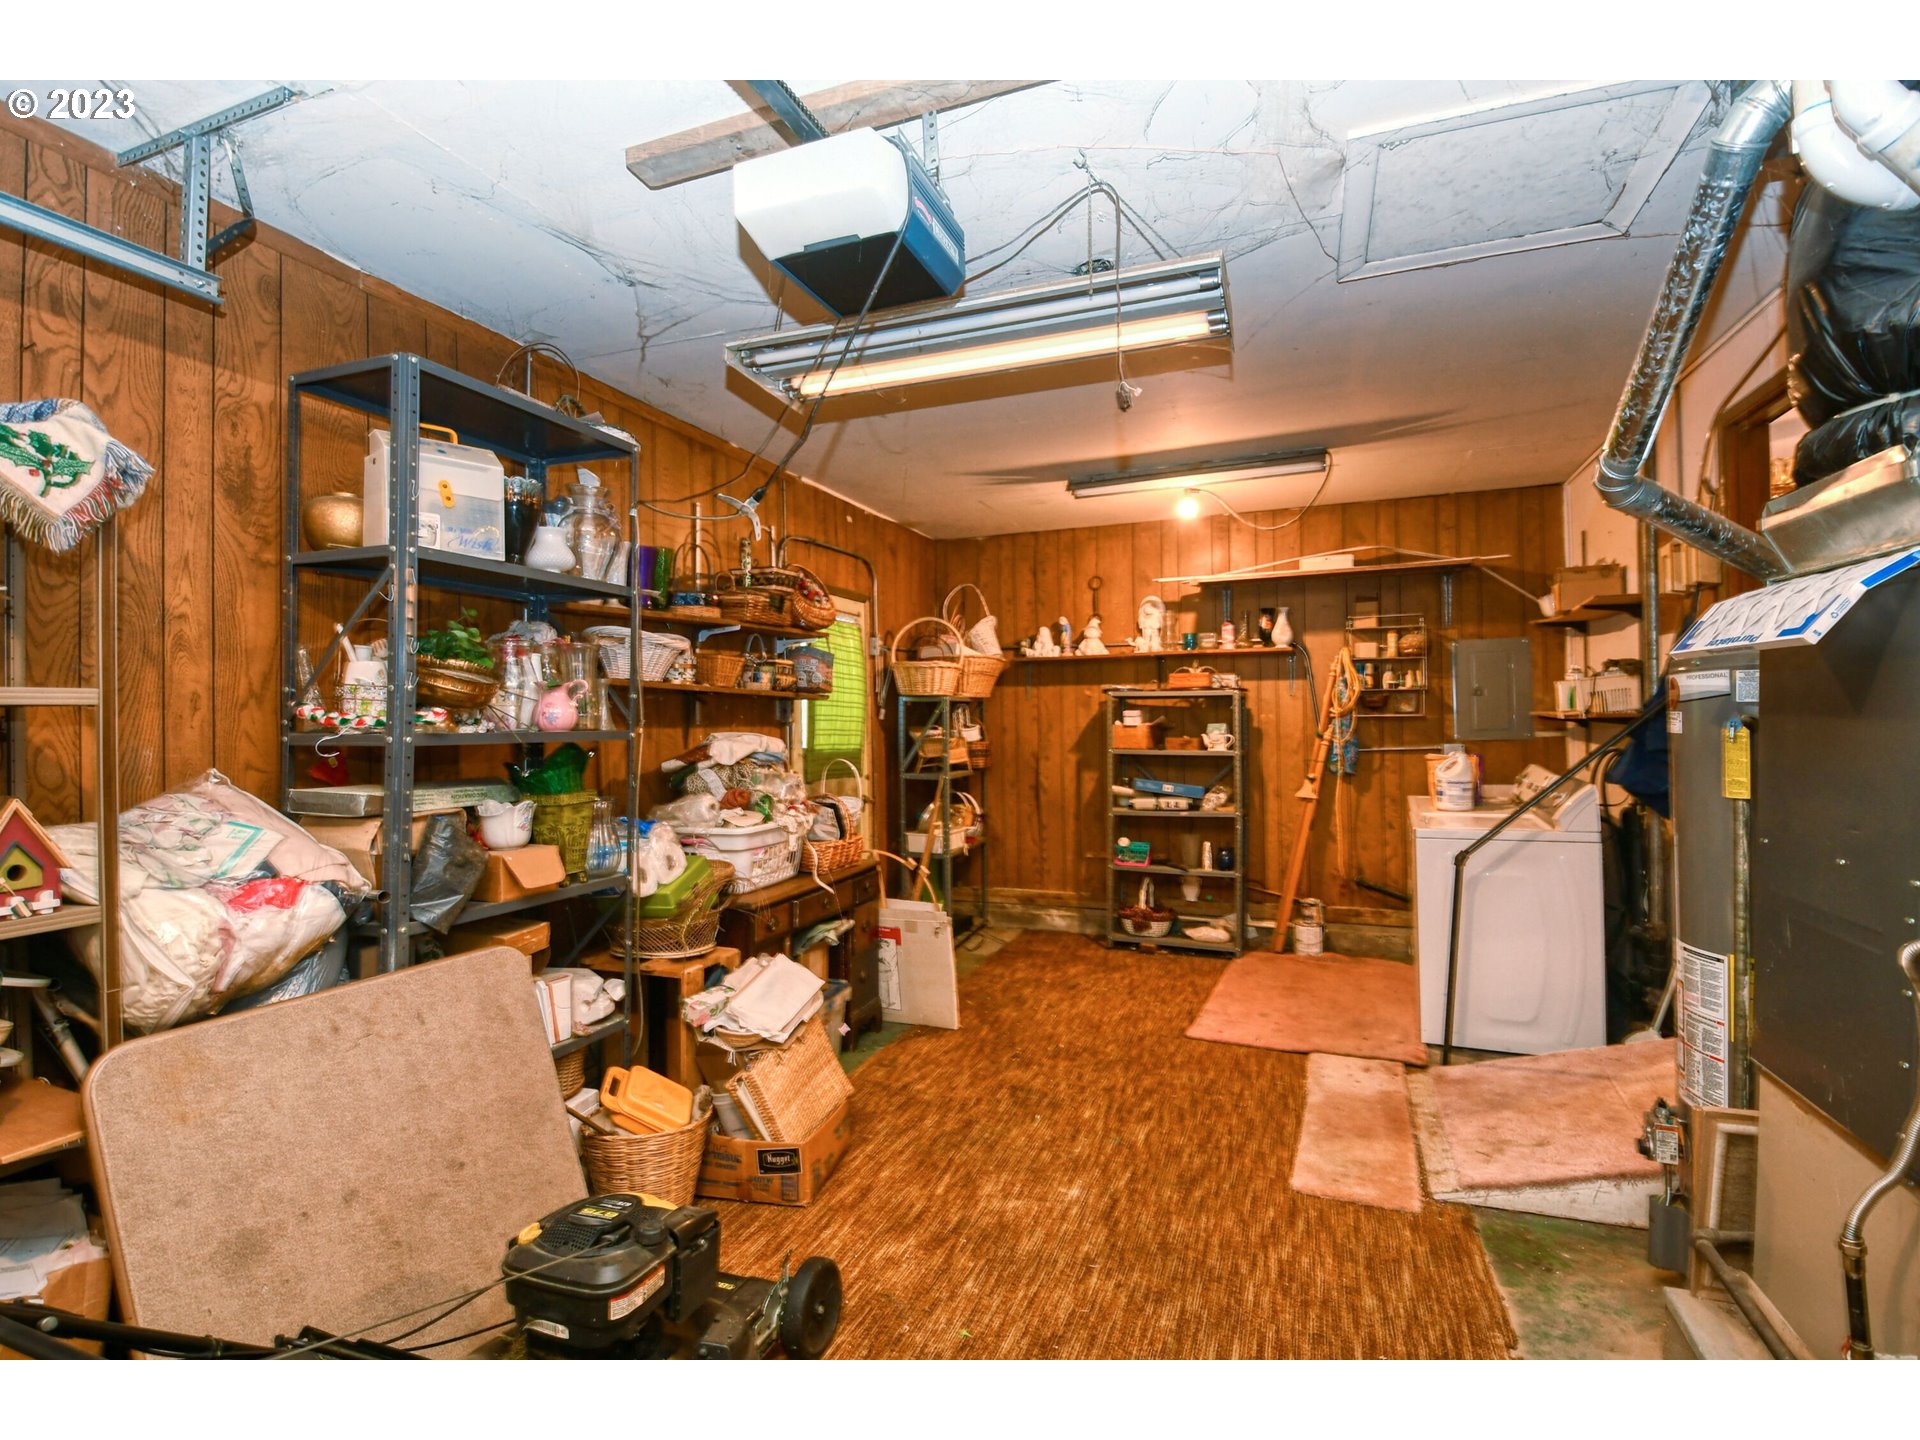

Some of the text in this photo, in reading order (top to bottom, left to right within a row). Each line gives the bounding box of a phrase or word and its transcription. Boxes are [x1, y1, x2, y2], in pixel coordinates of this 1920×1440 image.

[1704, 632, 1764, 647] Purolator
[1686, 671, 1728, 681] PROFESSIONAL
[766, 1153, 791, 1166] Nugget
